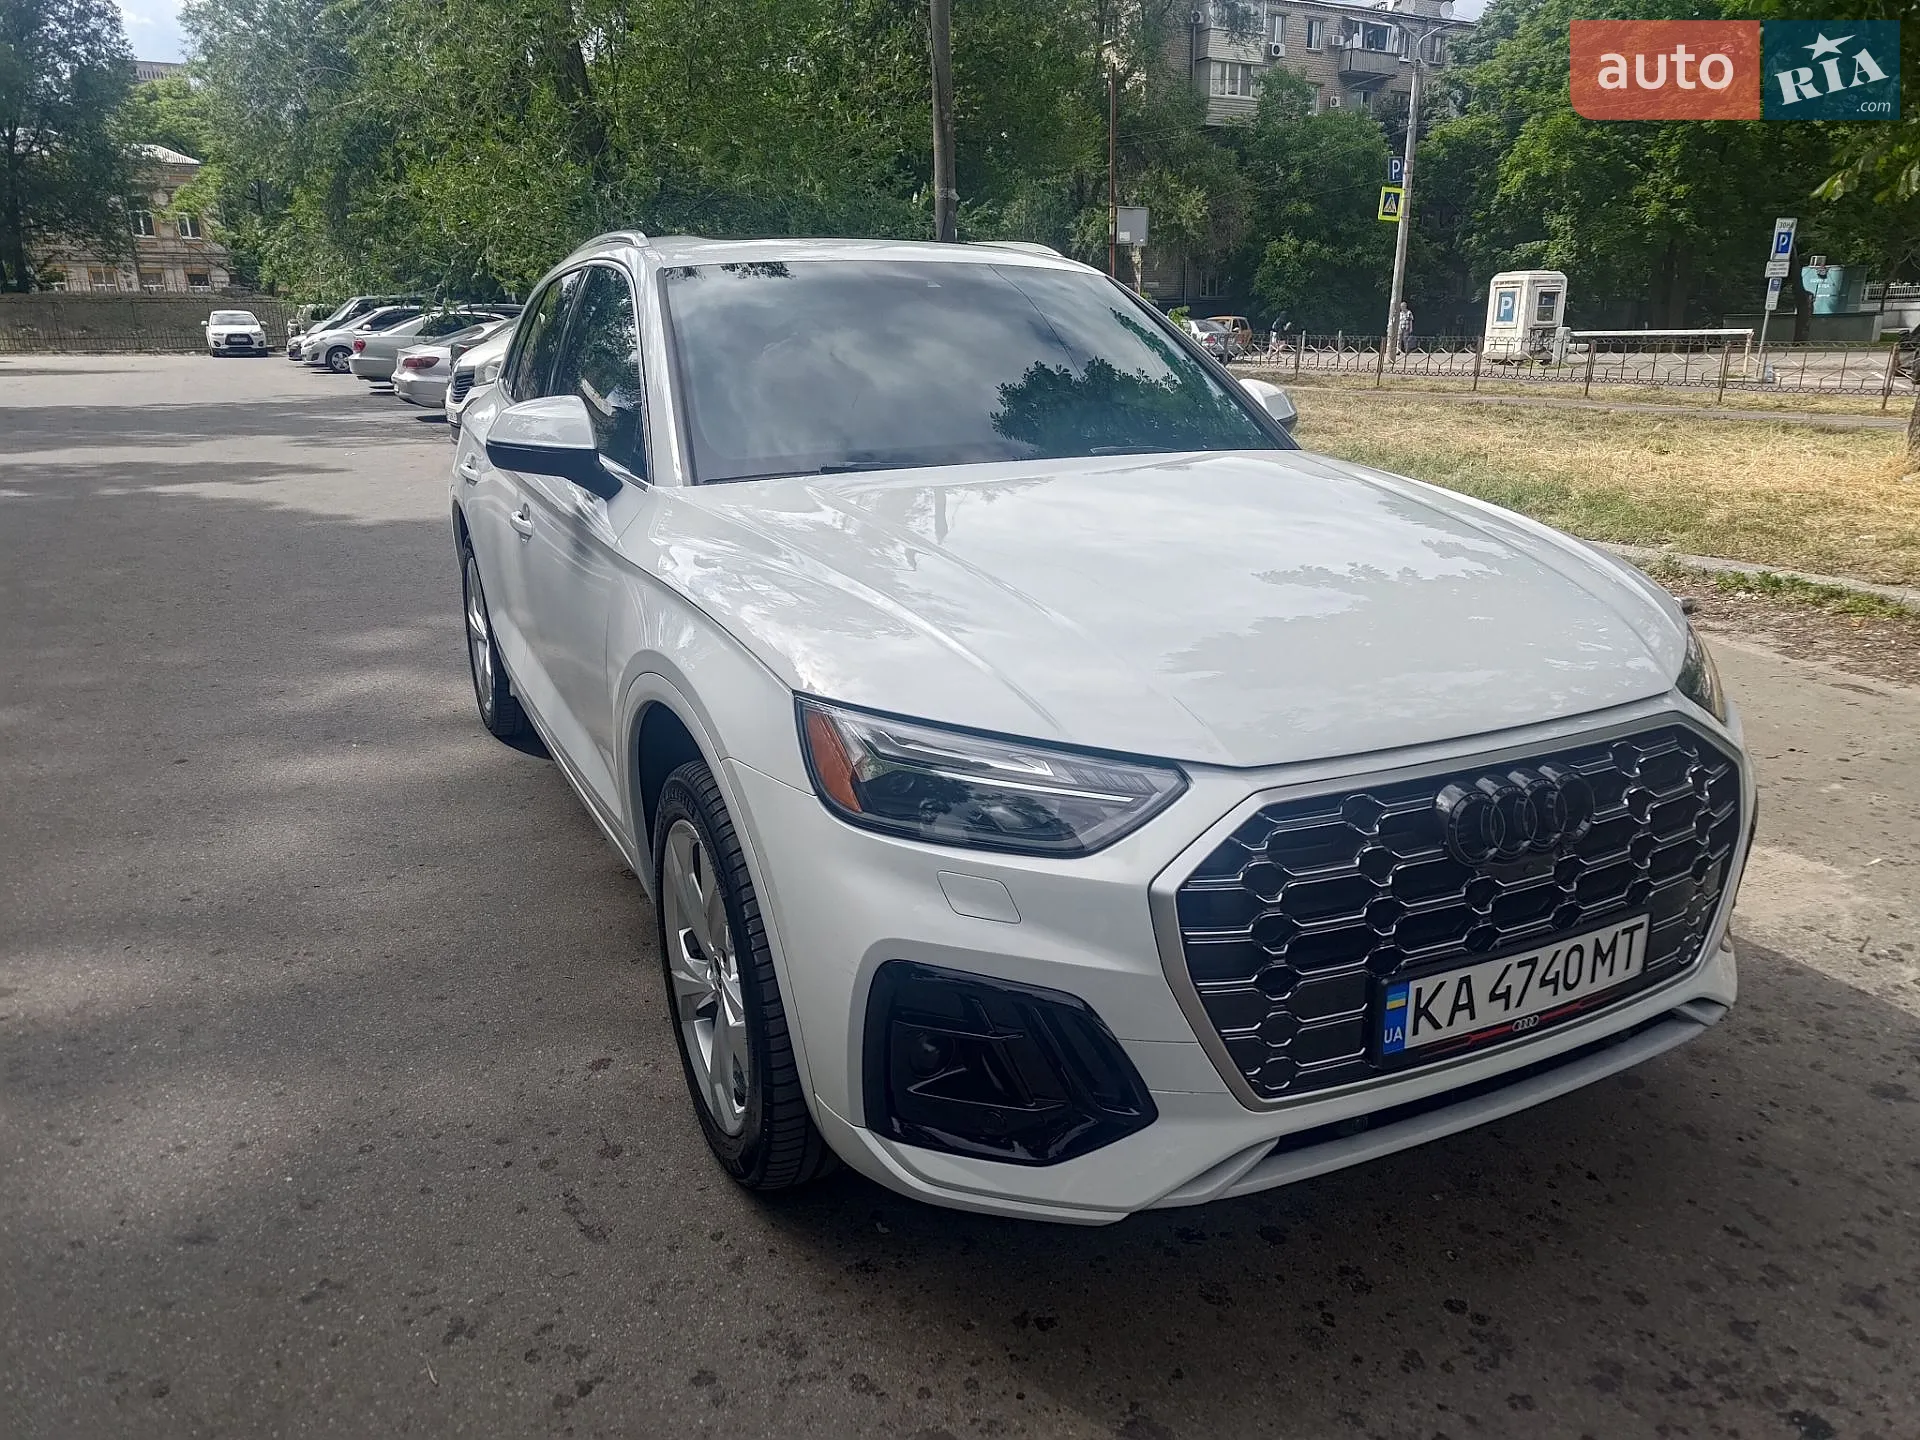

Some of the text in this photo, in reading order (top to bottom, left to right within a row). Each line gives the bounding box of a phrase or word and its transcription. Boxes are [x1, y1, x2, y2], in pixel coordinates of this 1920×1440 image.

[1392, 160, 1401, 179] P
[1779, 234, 1788, 252] P
[1500, 296, 1513, 317] P
[1412, 922, 1645, 1037] KA 4740 MT
[1384, 1027, 1403, 1044] UA
